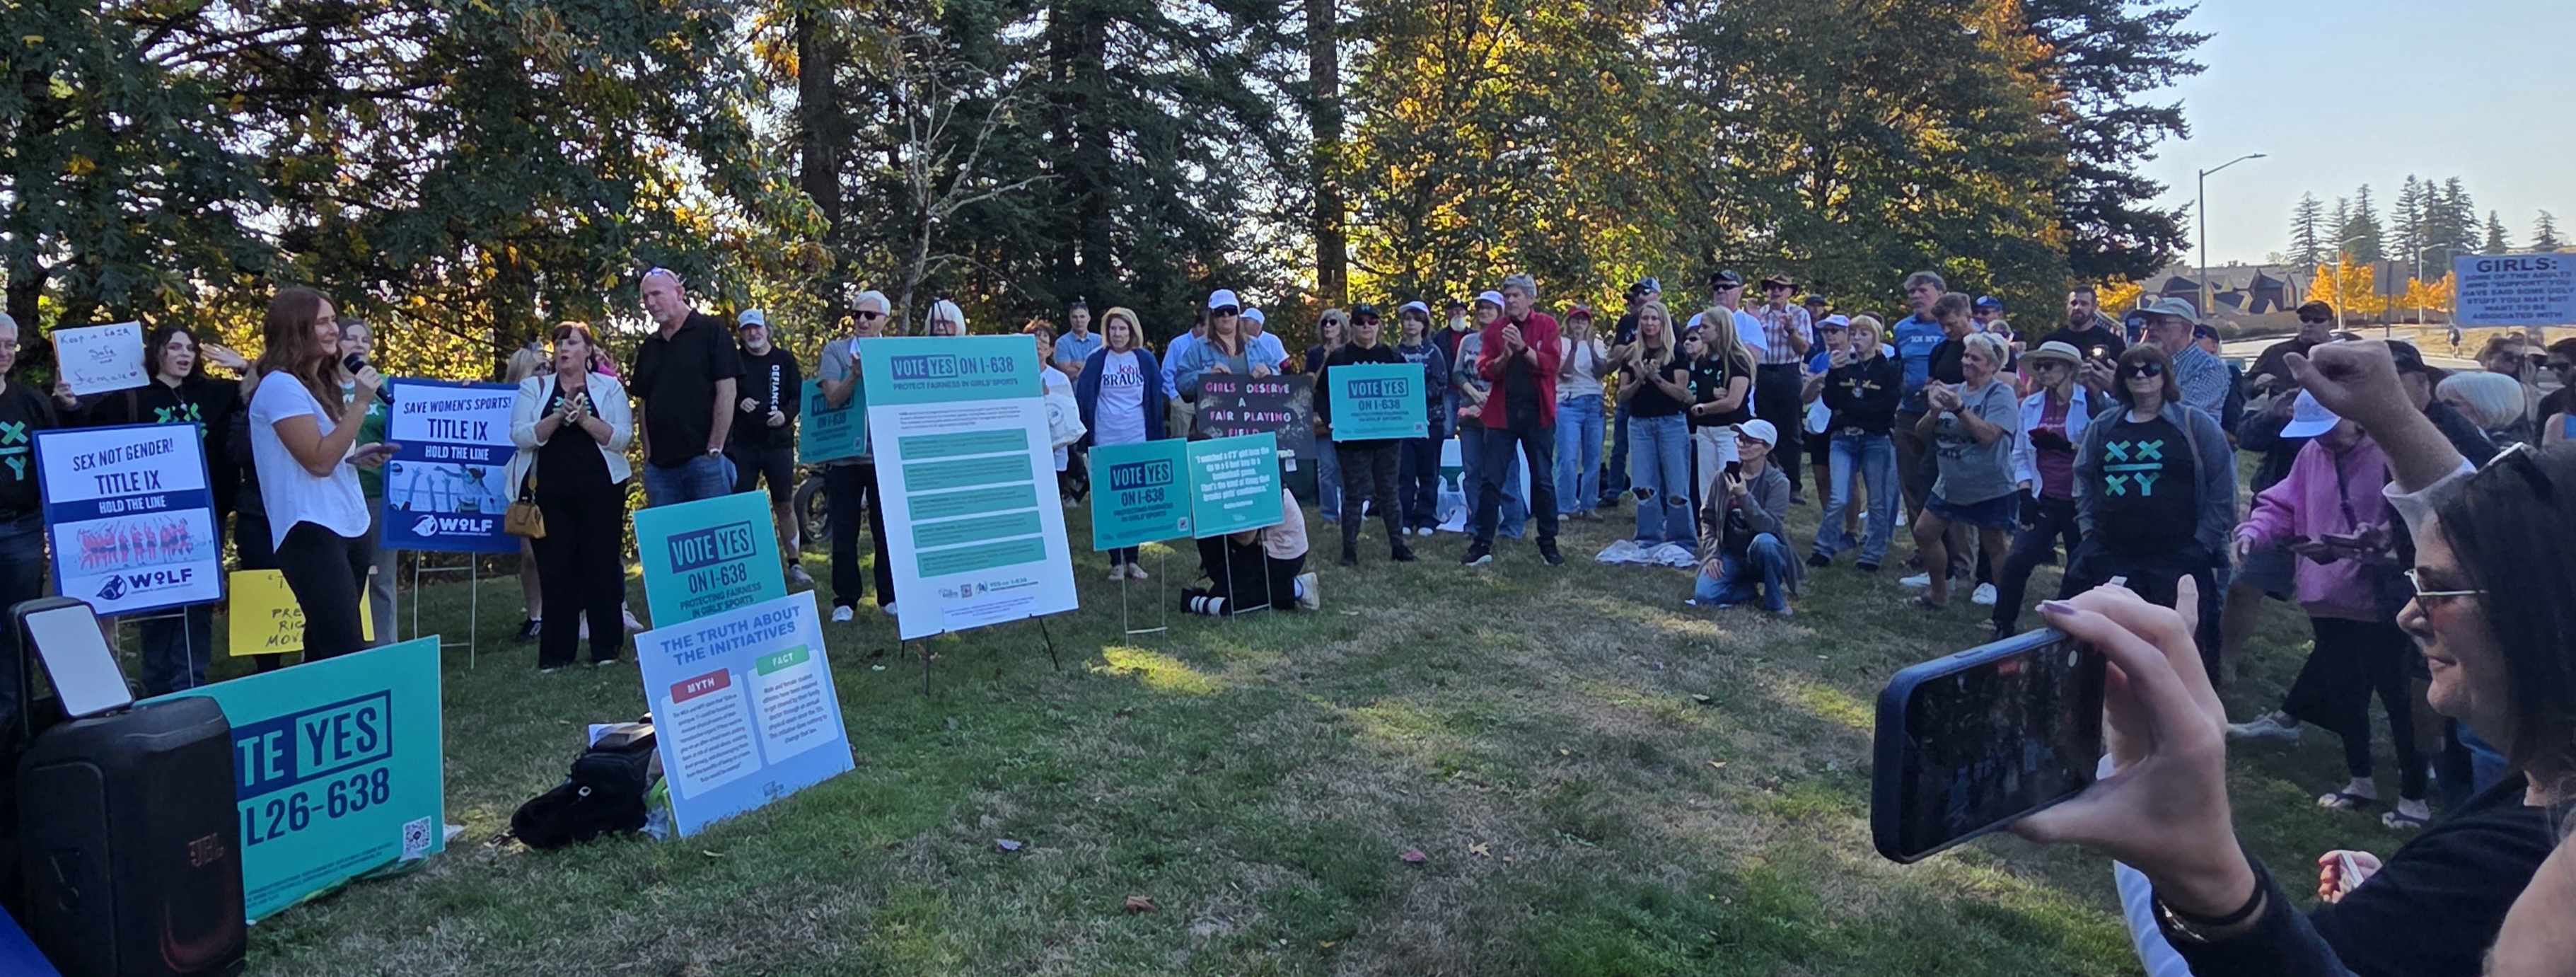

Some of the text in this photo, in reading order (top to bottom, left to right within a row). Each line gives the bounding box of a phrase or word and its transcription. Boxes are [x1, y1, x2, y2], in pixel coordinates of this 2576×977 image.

[2476, 257, 2558, 272] GIRLS:
[894, 357, 1014, 376] VOTE YES ON I-638
[893, 381, 925, 391] PROTECT
[927, 380, 961, 389] FAIRNESS
[992, 378, 1019, 386] SPORTS
[1205, 382, 1289, 394] GIRLS DESERVE
[1350, 381, 1404, 396] VOTE YES
[404, 396, 511, 415] SAVE WOMEN'S SPORTS!
[1238, 397, 1246, 407] A
[1358, 399, 1400, 410] ON I-638
[817, 416, 826, 429] ON
[1243, 412, 1292, 422] PLAYING
[427, 418, 488, 441] TITLE IX
[1228, 428, 1260, 437] FIELD
[73, 437, 174, 471] SEX NOT GENDER!
[425, 445, 489, 460] HOLD THE LINE
[94, 470, 161, 495] TITLE IX
[1113, 463, 1168, 487] VOTE YES
[2105, 472, 2161, 496] XY
[99, 495, 166, 514] HOLD THE LINE
[1121, 487, 1164, 507] ON I-638
[672, 528, 749, 566] VOTE YES
[688, 562, 747, 594] ON I-638
[680, 582, 762, 611] PROTECTING FAIRNESS
[692, 608, 700, 618] IN
[724, 594, 754, 609] SPORTS
[272, 608, 301, 618] PRE
[660, 606, 801, 654] THE TRUTH ABOUT
[265, 633, 303, 647] MOV
[673, 621, 796, 666] THE INITIATIVES
[772, 652, 794, 667] FACT
[687, 678, 715, 694] MYTH
[237, 707, 378, 787] TE YES
[246, 767, 390, 847] L26-638
